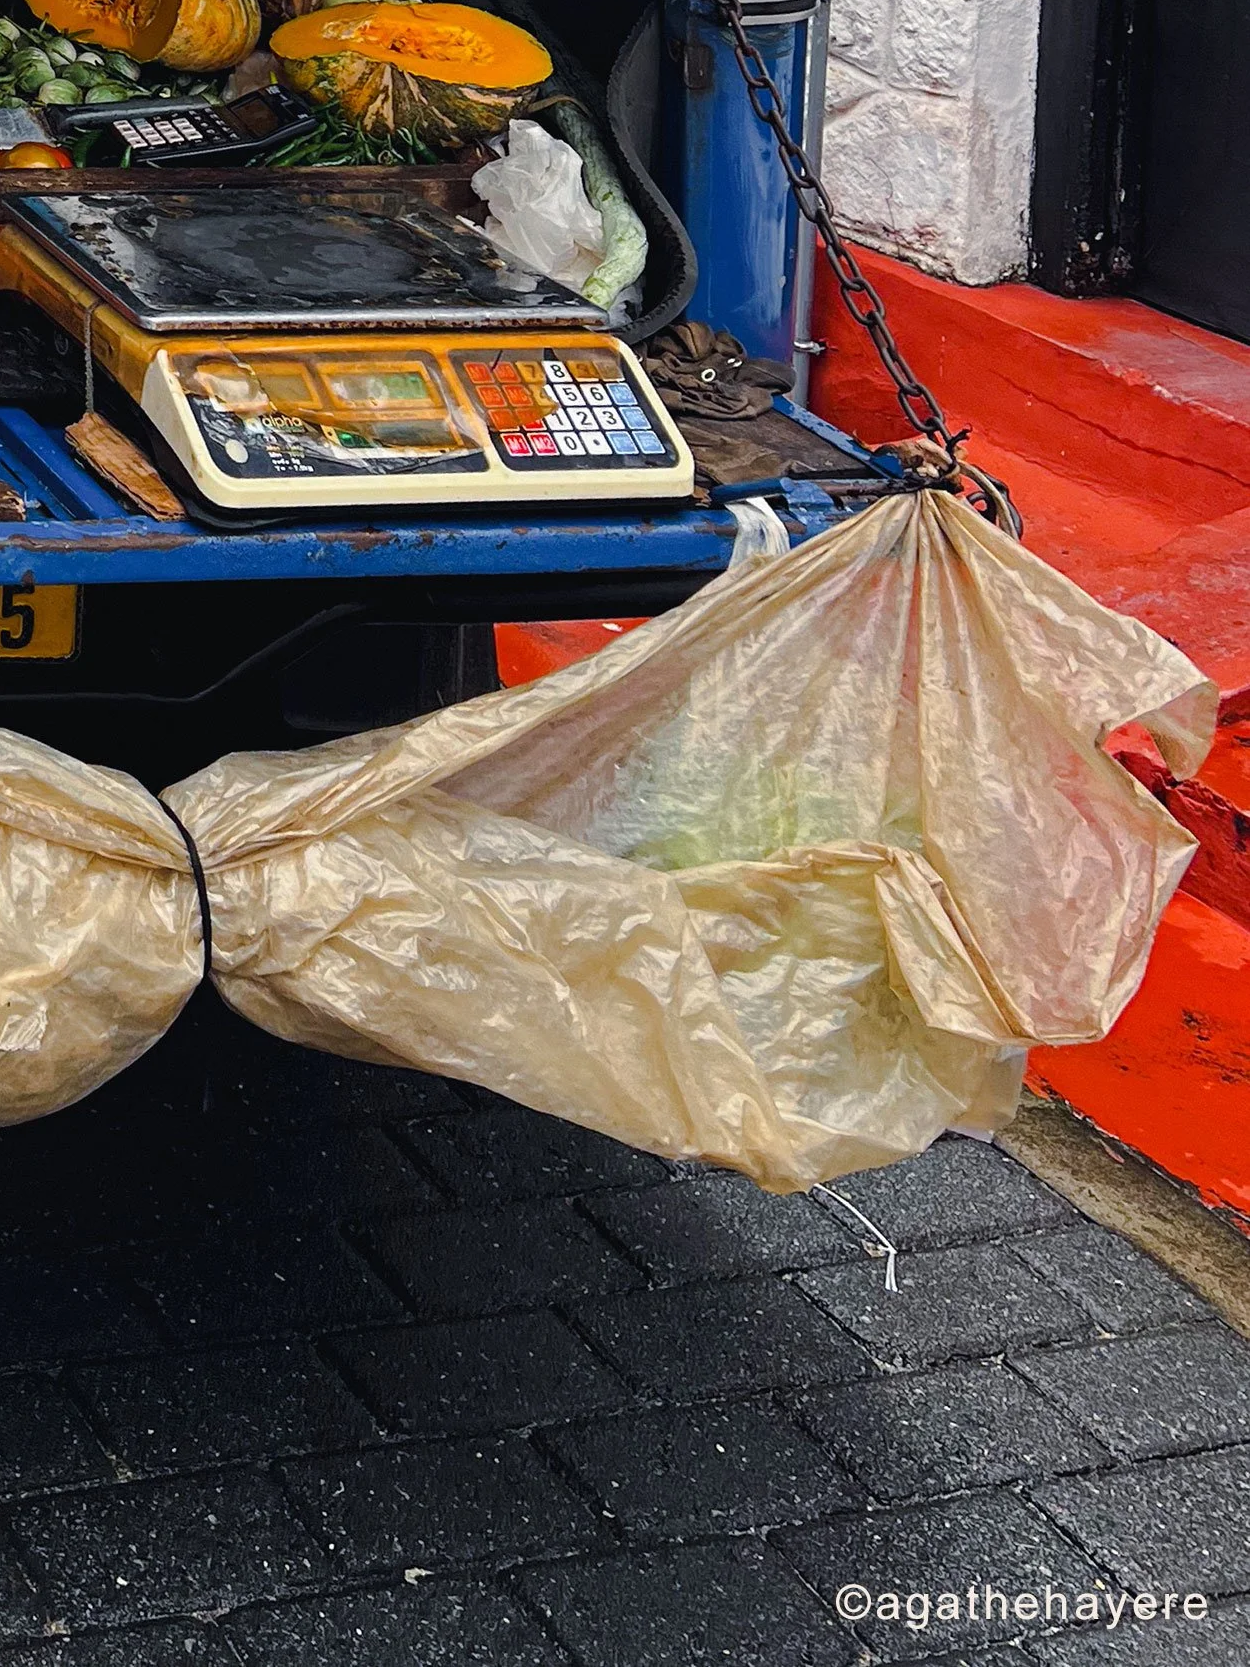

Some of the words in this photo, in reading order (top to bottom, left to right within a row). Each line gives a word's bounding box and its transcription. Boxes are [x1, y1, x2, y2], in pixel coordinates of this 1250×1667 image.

[550, 364, 565, 378] 8
[562, 387, 578, 402] 5
[590, 387, 604, 401] 6
[262, 414, 303, 430] alpha
[576, 411, 592, 426] 2
[602, 410, 617, 425] 3
[507, 437, 527, 451] M1
[532, 437, 554, 450] M2
[564, 435, 578, 450] 0
